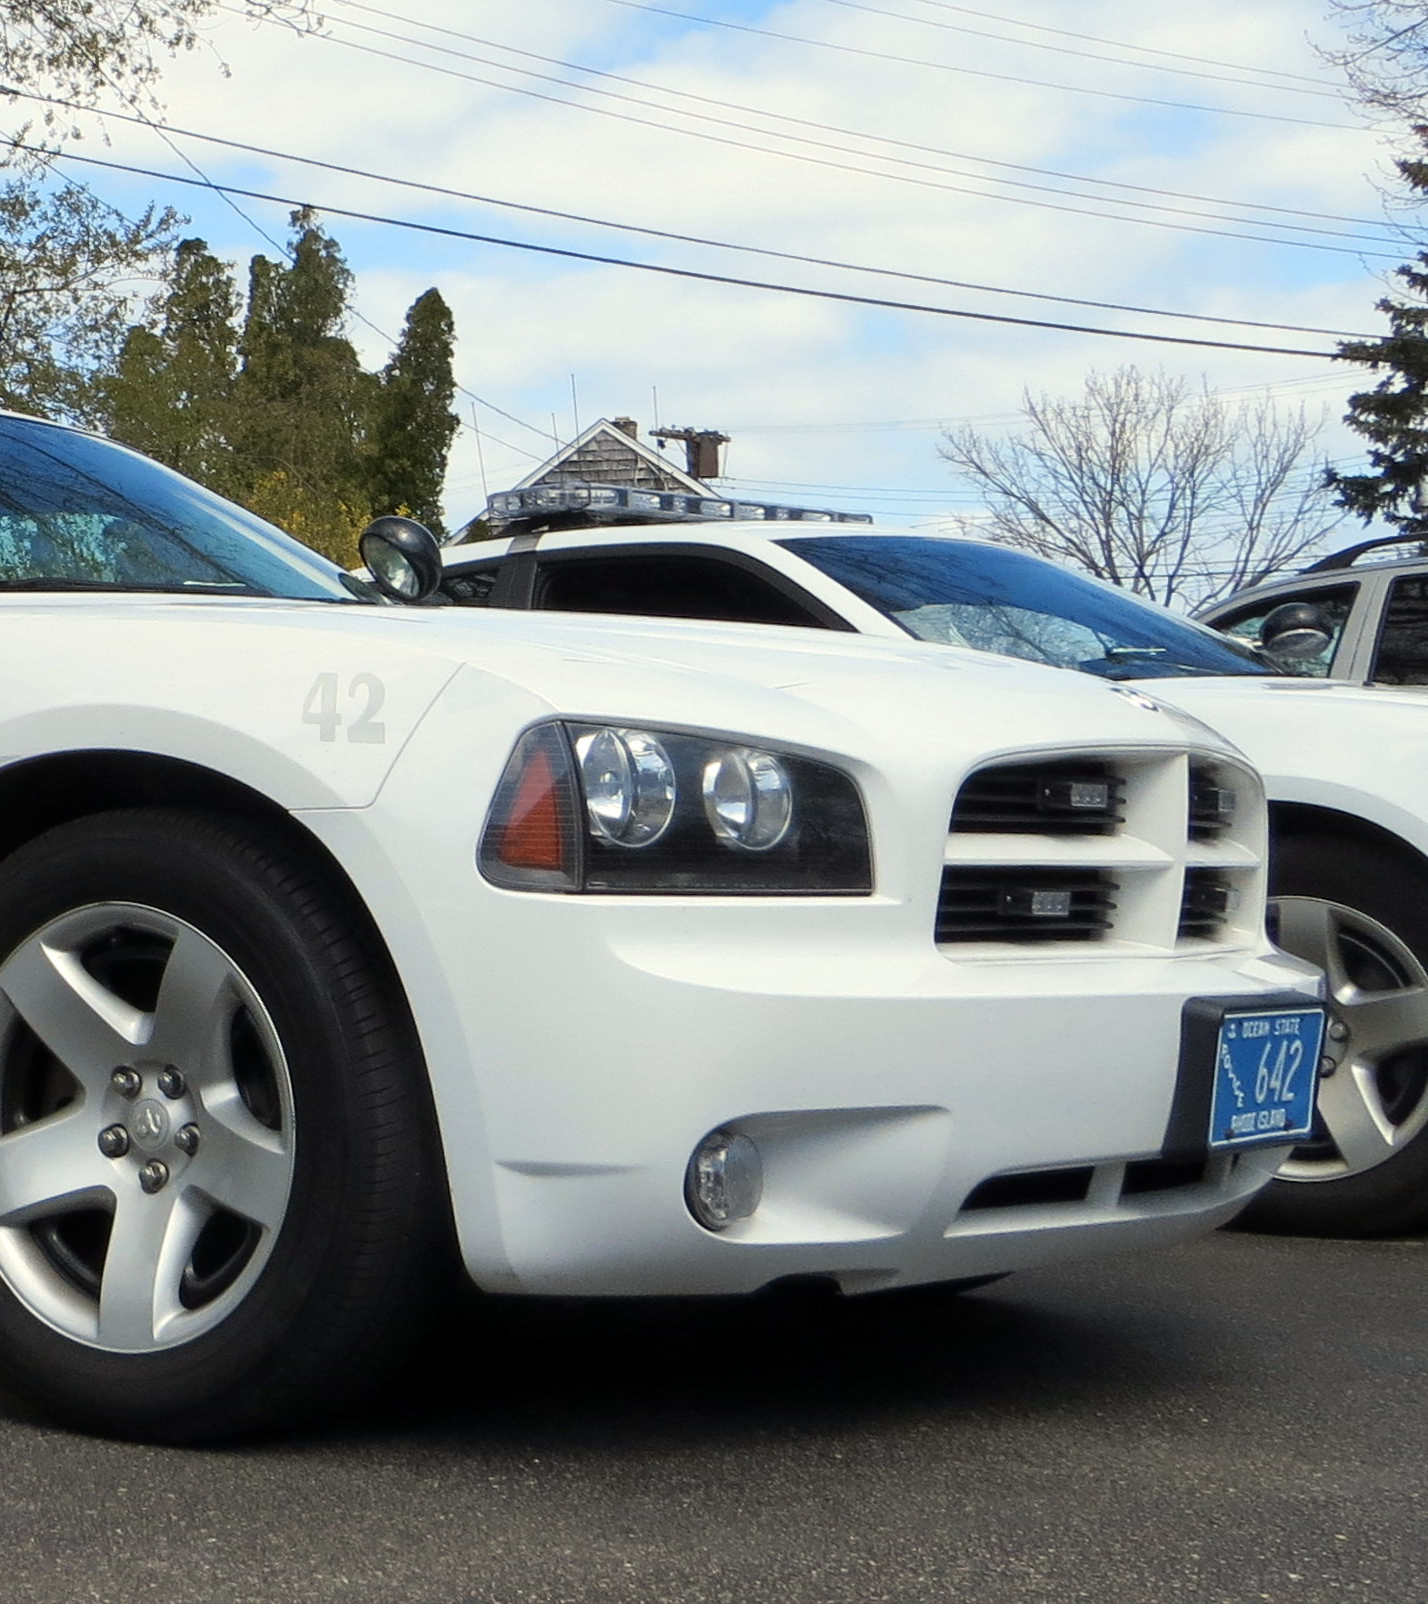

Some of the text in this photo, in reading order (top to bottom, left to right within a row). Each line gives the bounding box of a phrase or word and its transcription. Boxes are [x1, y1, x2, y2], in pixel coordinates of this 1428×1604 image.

[301, 672, 386, 744] 42
[1243, 1018, 1301, 1038] OCEAN STATE
[1255, 1039, 1303, 1104] 642
